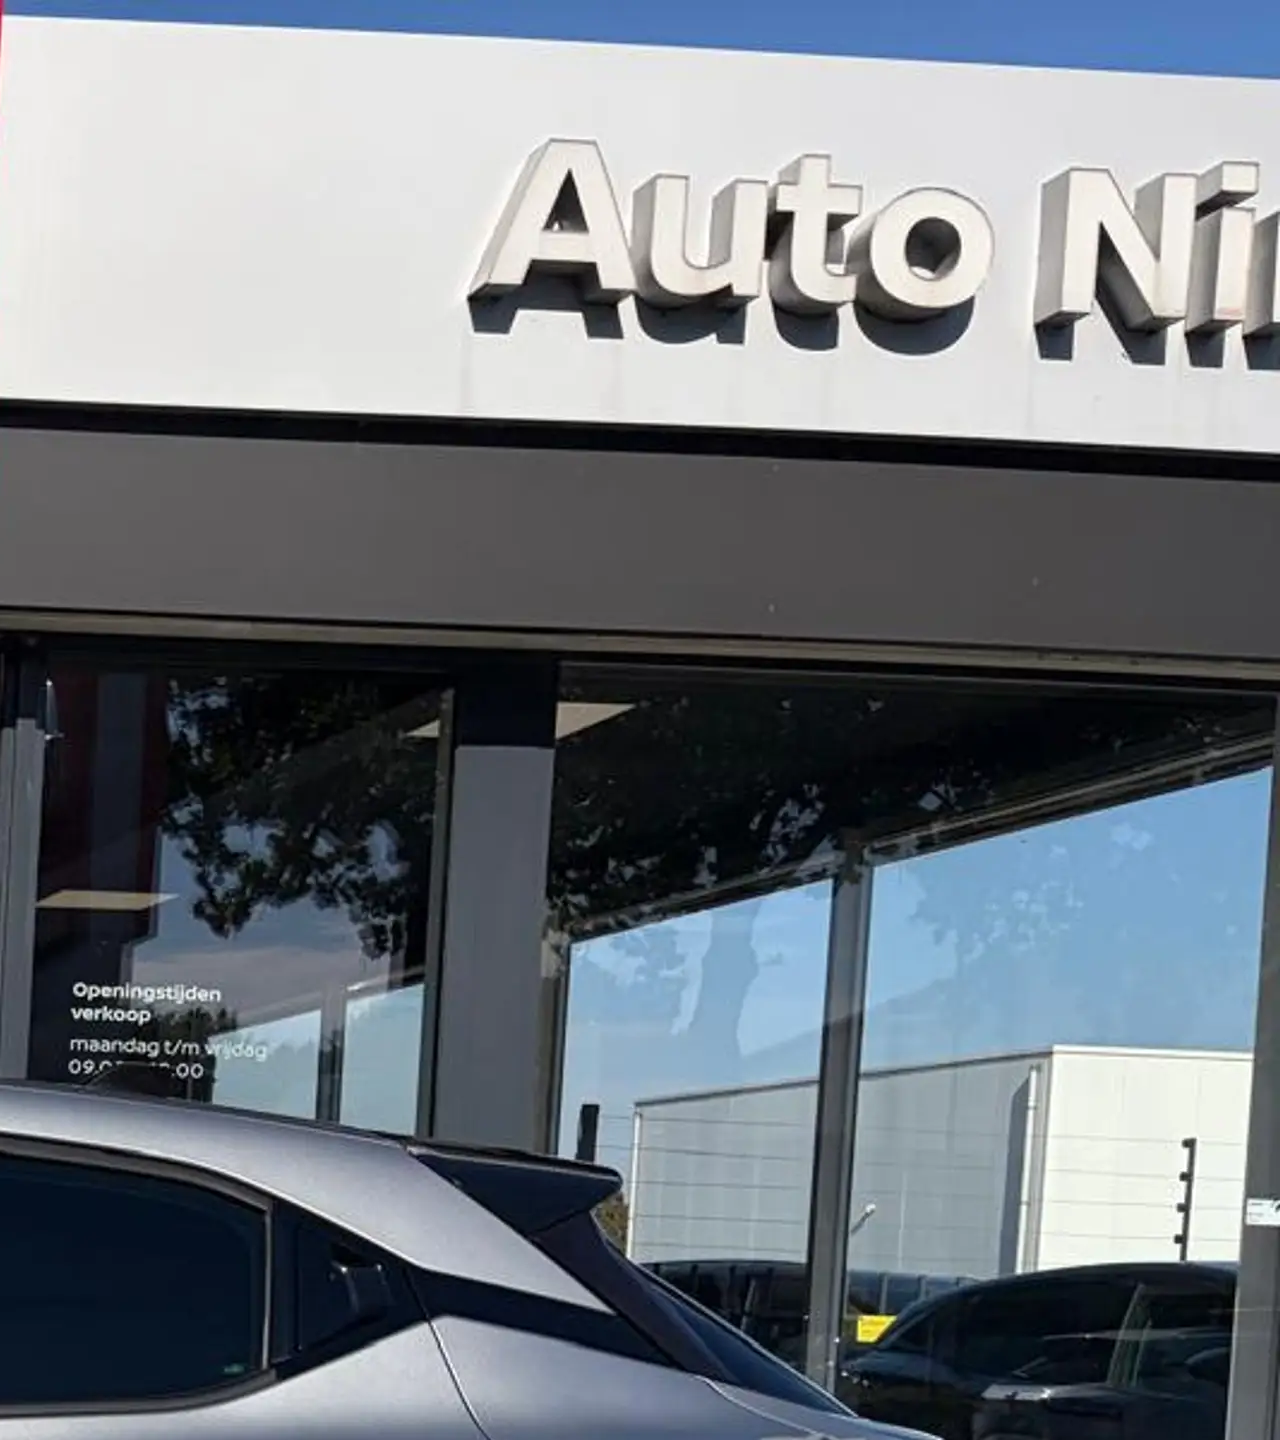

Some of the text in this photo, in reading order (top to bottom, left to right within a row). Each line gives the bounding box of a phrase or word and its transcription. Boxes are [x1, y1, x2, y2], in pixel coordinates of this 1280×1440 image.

[467, 137, 1280, 338] Auto Ni
[72, 981, 222, 1005] Openingstijden
[70, 1005, 152, 1026] verkoop
[69, 1037, 268, 1063] maandag t/m vrijdag
